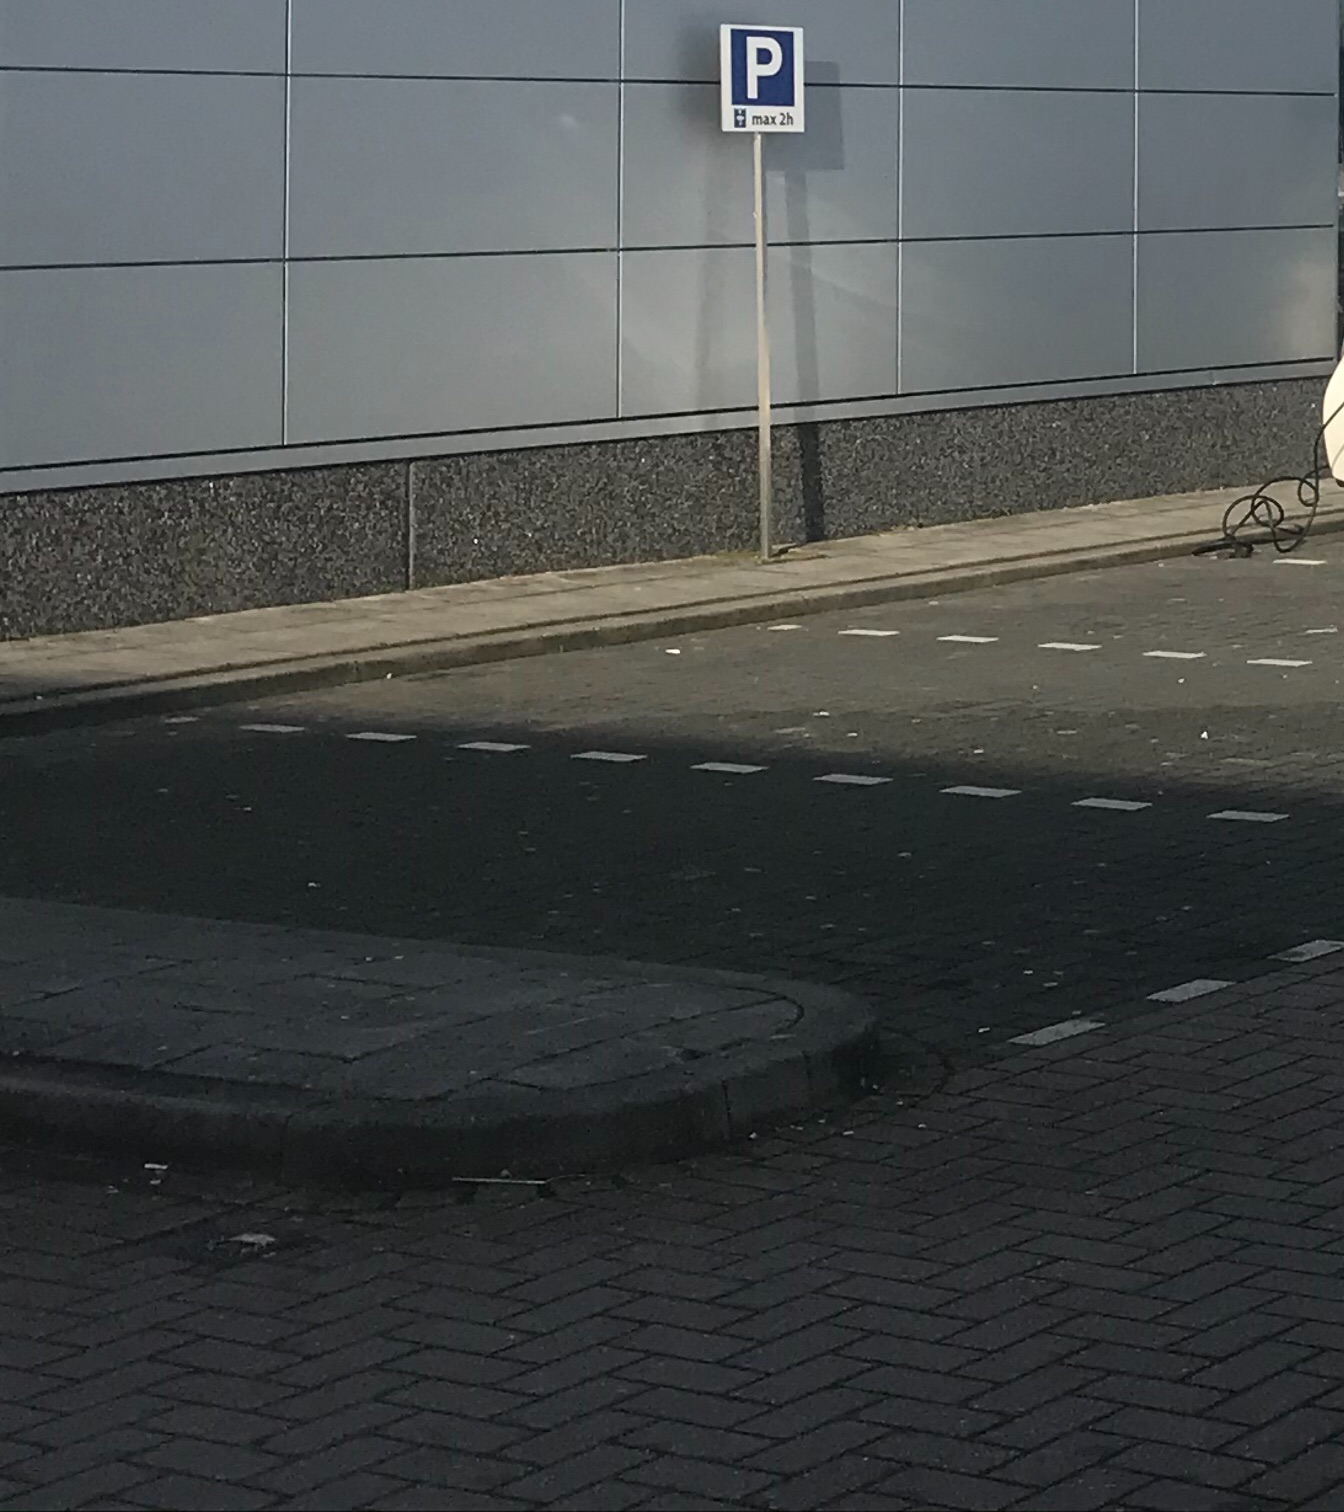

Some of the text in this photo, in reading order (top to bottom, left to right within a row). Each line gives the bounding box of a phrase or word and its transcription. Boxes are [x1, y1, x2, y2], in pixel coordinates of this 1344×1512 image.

[746, 36, 783, 99] P
[752, 113, 794, 126] max 2h
